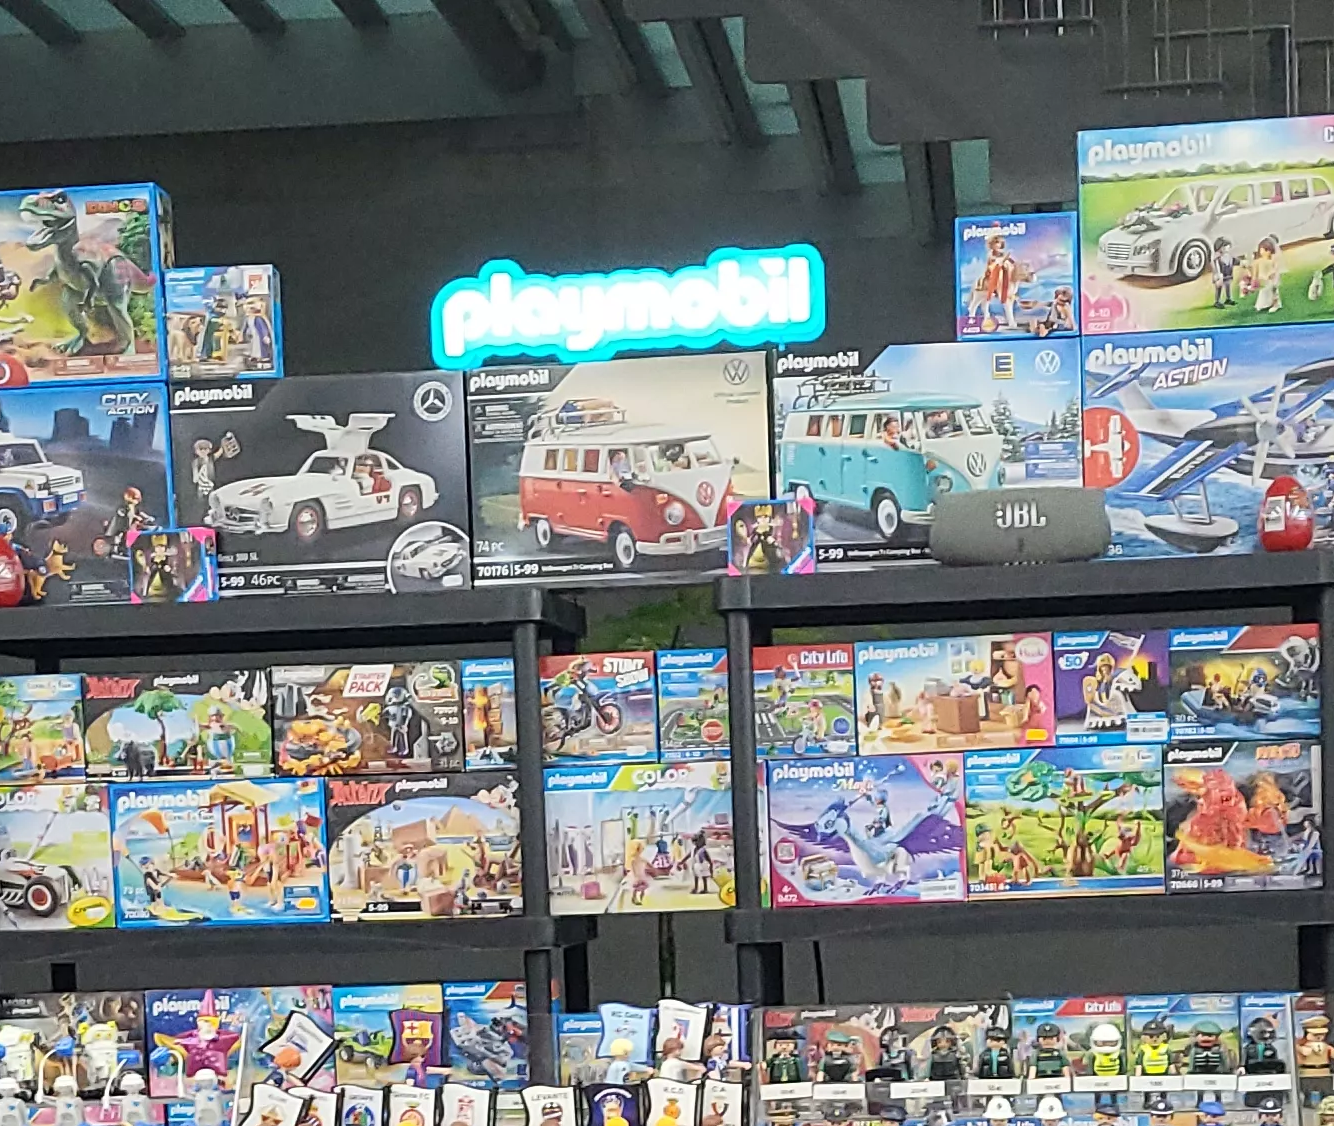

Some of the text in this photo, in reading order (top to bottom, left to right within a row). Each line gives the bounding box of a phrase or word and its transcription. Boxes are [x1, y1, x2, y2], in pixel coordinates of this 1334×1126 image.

[1087, 133, 1213, 168] playmobil
[441, 254, 812, 358] playmobil
[776, 351, 860, 373] playmobil
[1088, 337, 1214, 371] playmobil
[469, 368, 550, 392] playmobil
[1152, 357, 1229, 391] ACTION
[100, 392, 151, 407] CITY
[173, 384, 254, 406] playmobil
[107, 404, 155, 416] ACTION
[1001, 500, 1048, 529] JBL
[817, 548, 845, 561] 5-99
[476, 562, 539, 577] 70176 5-99
[220, 576, 245, 588] 5-99
[250, 573, 282, 587] 46 PC
[1172, 630, 1229, 645] playmobil
[660, 652, 714, 668] playmobil
[800, 649, 849, 666] City Life
[858, 643, 940, 666] playmobil
[601, 657, 646, 673] STUNT
[616, 667, 650, 688] SHOW
[347, 681, 385, 694] PACK
[967, 752, 1020, 767] playmobil
[1167, 747, 1223, 763] playmobil
[547, 771, 608, 788] playmobil
[772, 761, 855, 784] playmobil
[395, 777, 448, 793] playmobil
[117, 790, 210, 811] playmobil
